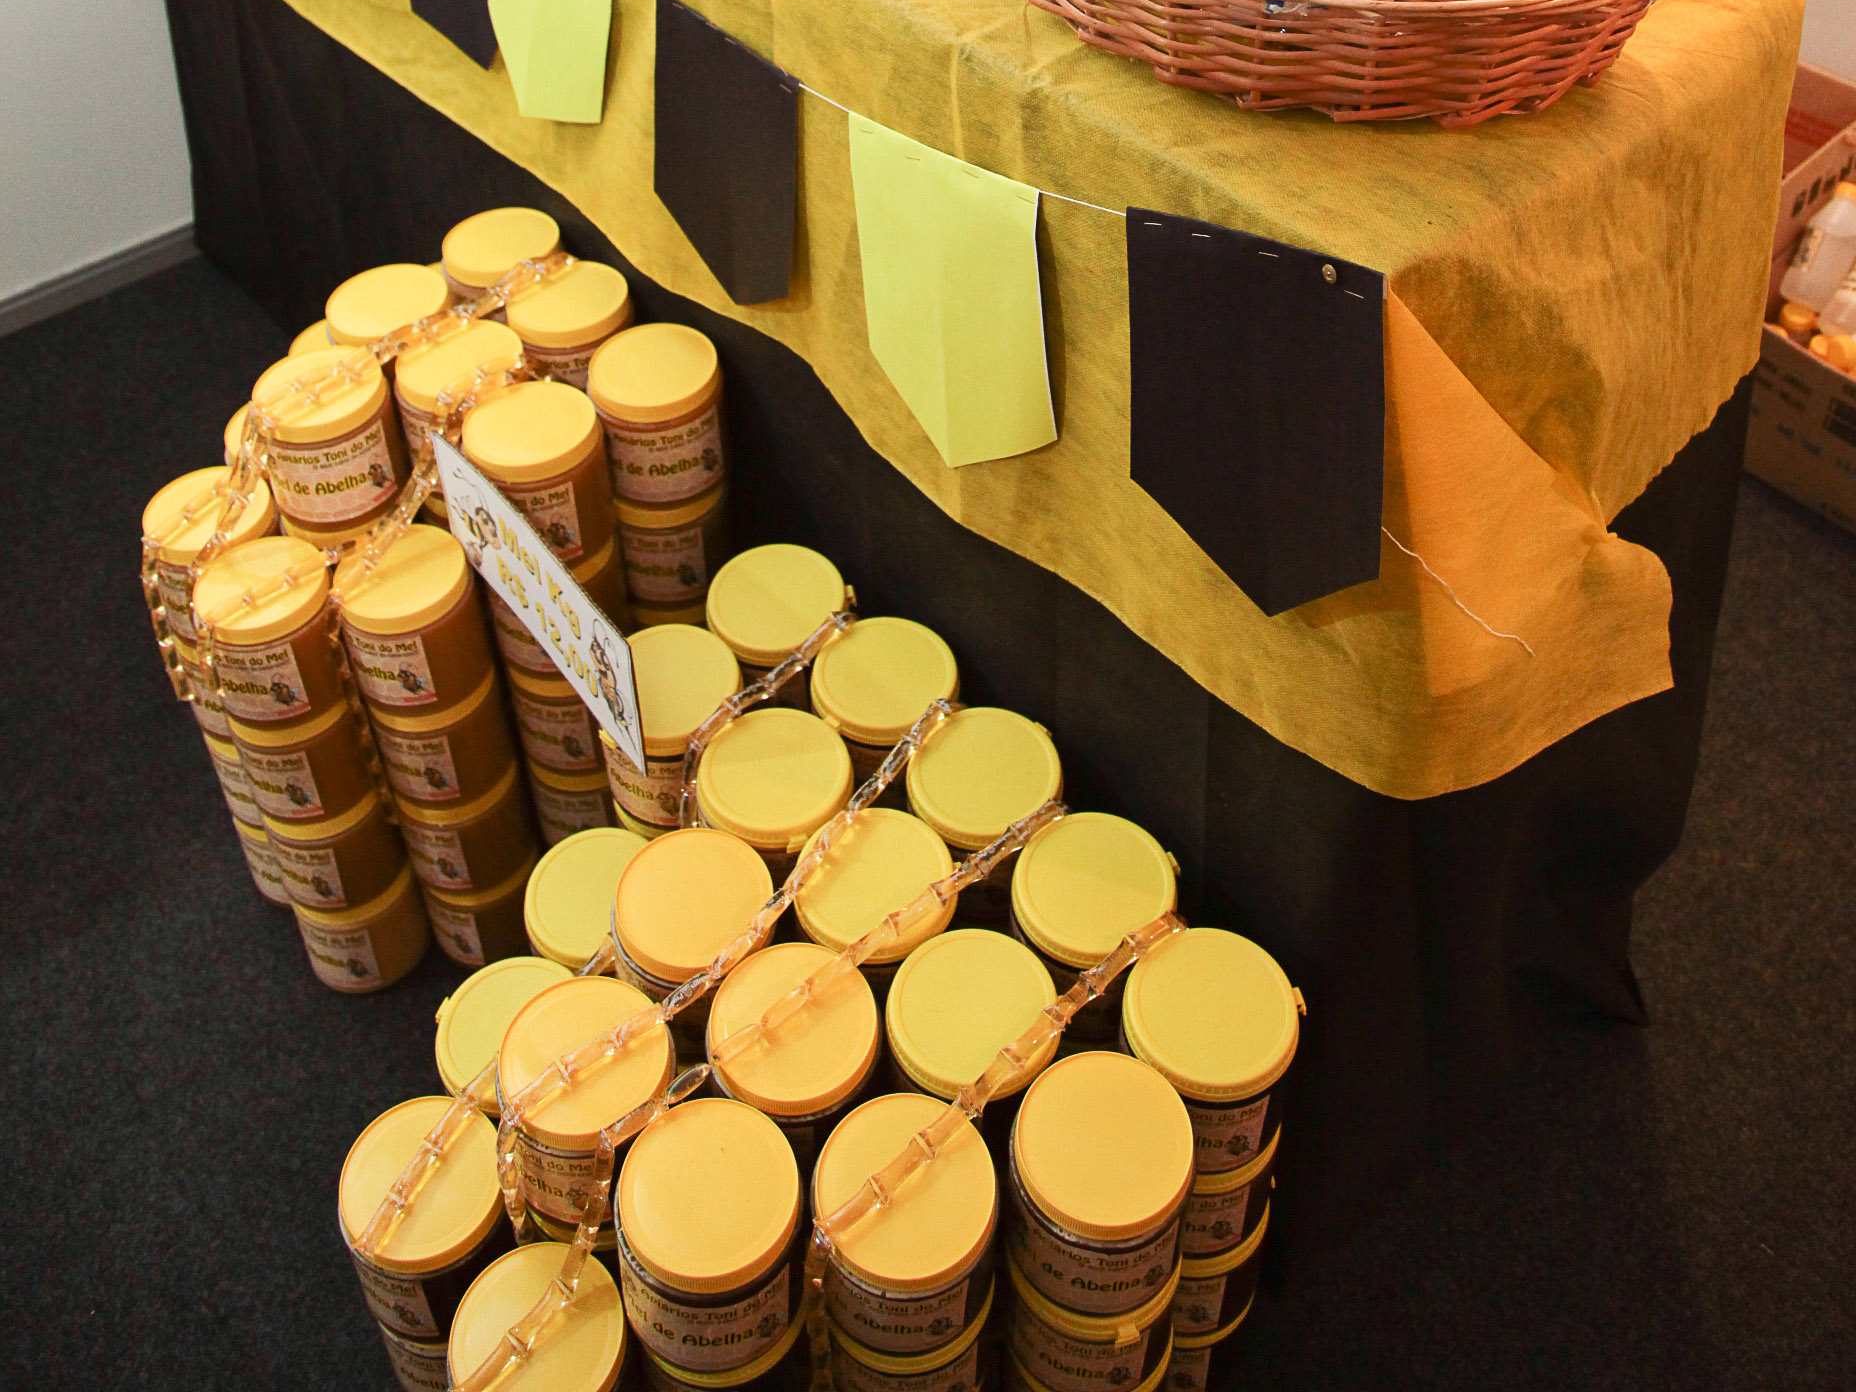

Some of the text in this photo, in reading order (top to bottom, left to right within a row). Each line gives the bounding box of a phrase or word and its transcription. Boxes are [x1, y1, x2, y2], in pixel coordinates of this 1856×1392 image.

[322, 449, 348, 464] Toni
[350, 441, 363, 454] do
[365, 429, 382, 445] Mel
[626, 462, 645, 477] de
[649, 456, 701, 477] Abelha
[293, 481, 310, 496] de
[315, 472, 368, 496] Abelha
[530, 495, 545, 506] do
[548, 488, 569, 503] Mel
[499, 516, 582, 641] Mel Kg
[497, 554, 600, 699] R$ 12,00
[378, 642, 393, 653] do
[395, 640, 417, 653] Mel
[224, 654, 246, 666] Toni
[248, 654, 264, 666] do
[265, 649, 290, 664] Mel
[222, 677, 270, 696] Abelha
[1217, 1111, 1235, 1123] do
[1240, 1102, 1264, 1120] Mel
[546, 1160, 565, 1171] do
[1200, 1191, 1245, 1208] do Mel
[1097, 1258, 1129, 1268] Toni
[1133, 1250, 1151, 1263] do
[1041, 1261, 1064, 1280] de
[1070, 1276, 1142, 1293] Abelha
[704, 1309, 738, 1321] Toni
[878, 1301, 909, 1314] Toni
[853, 1312, 924, 1335] Abelha
[652, 1321, 675, 1341] de
[681, 1326, 754, 1348] Abelha
[1038, 1351, 1104, 1380] Abelha
